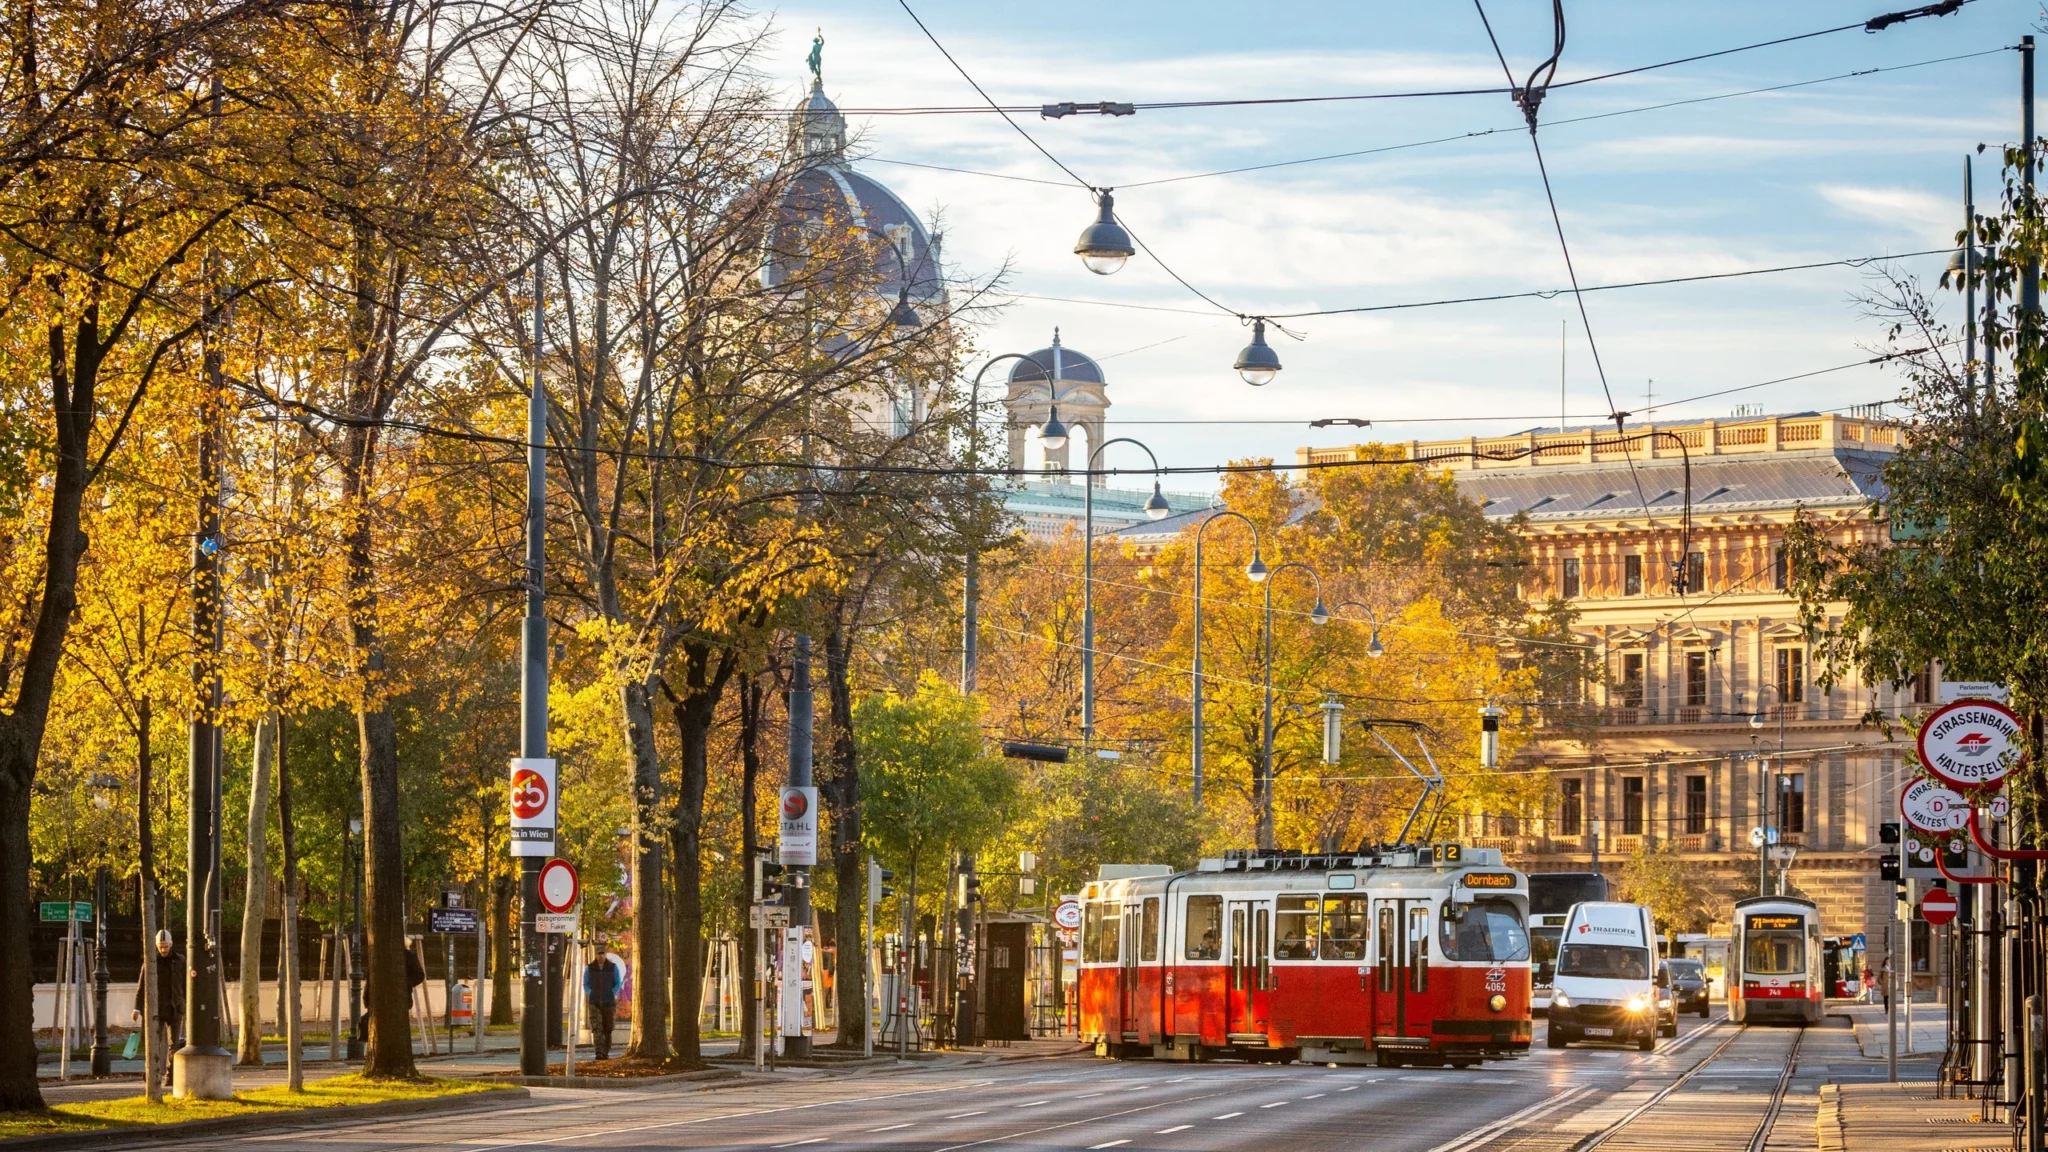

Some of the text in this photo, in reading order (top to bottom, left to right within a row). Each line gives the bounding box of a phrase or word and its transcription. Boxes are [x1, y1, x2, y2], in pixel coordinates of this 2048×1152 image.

[1936, 751, 2015, 777] HALTESTELL
[1933, 801, 1943, 812] D
[1993, 801, 2006, 812] 71
[1911, 810, 1947, 827] HALTEST
[1953, 813, 1960, 825] 1
[520, 829, 528, 838] in
[528, 830, 549, 839] Wien
[1447, 846, 1457, 859] 2
[1909, 842, 1917, 851] D
[1436, 847, 1442, 859] 2
[1924, 851, 1929, 859] 1
[1467, 874, 1510, 886] Dornbach
[1752, 917, 1762, 929] 71
[1485, 982, 1506, 992] 4062
